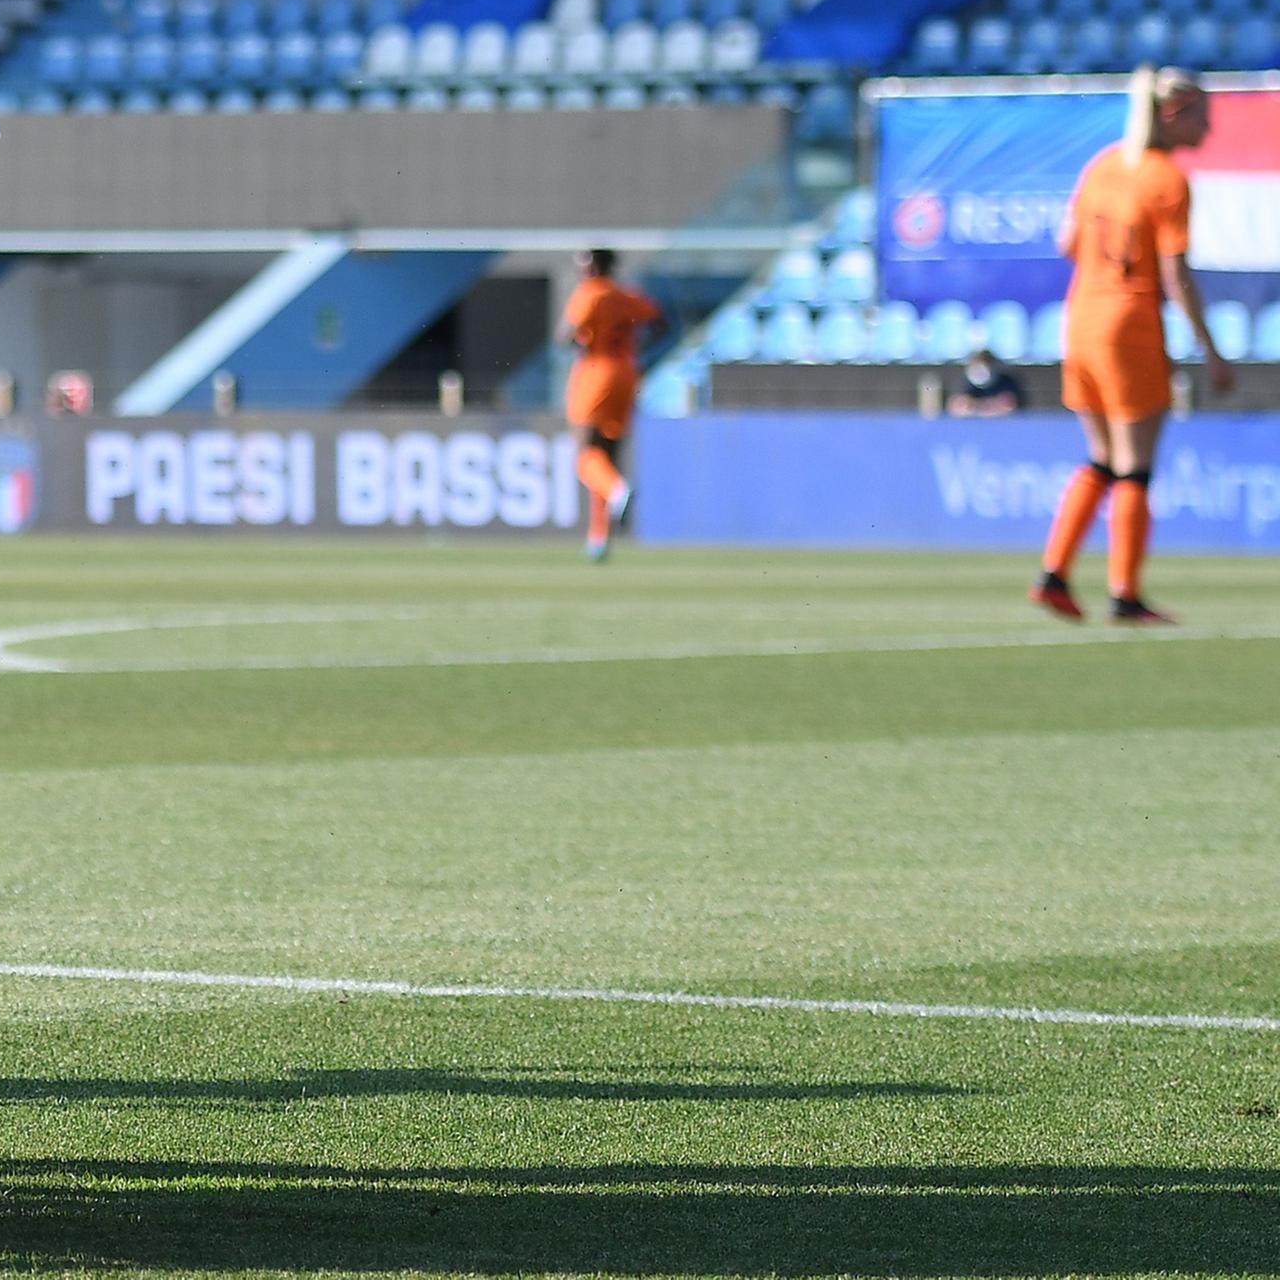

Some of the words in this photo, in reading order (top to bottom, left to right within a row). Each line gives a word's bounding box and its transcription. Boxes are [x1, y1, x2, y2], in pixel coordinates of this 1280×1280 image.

[951, 192, 1067, 244] RESP
[85, 431, 316, 525] PAESI
[337, 431, 579, 527] BASSI
